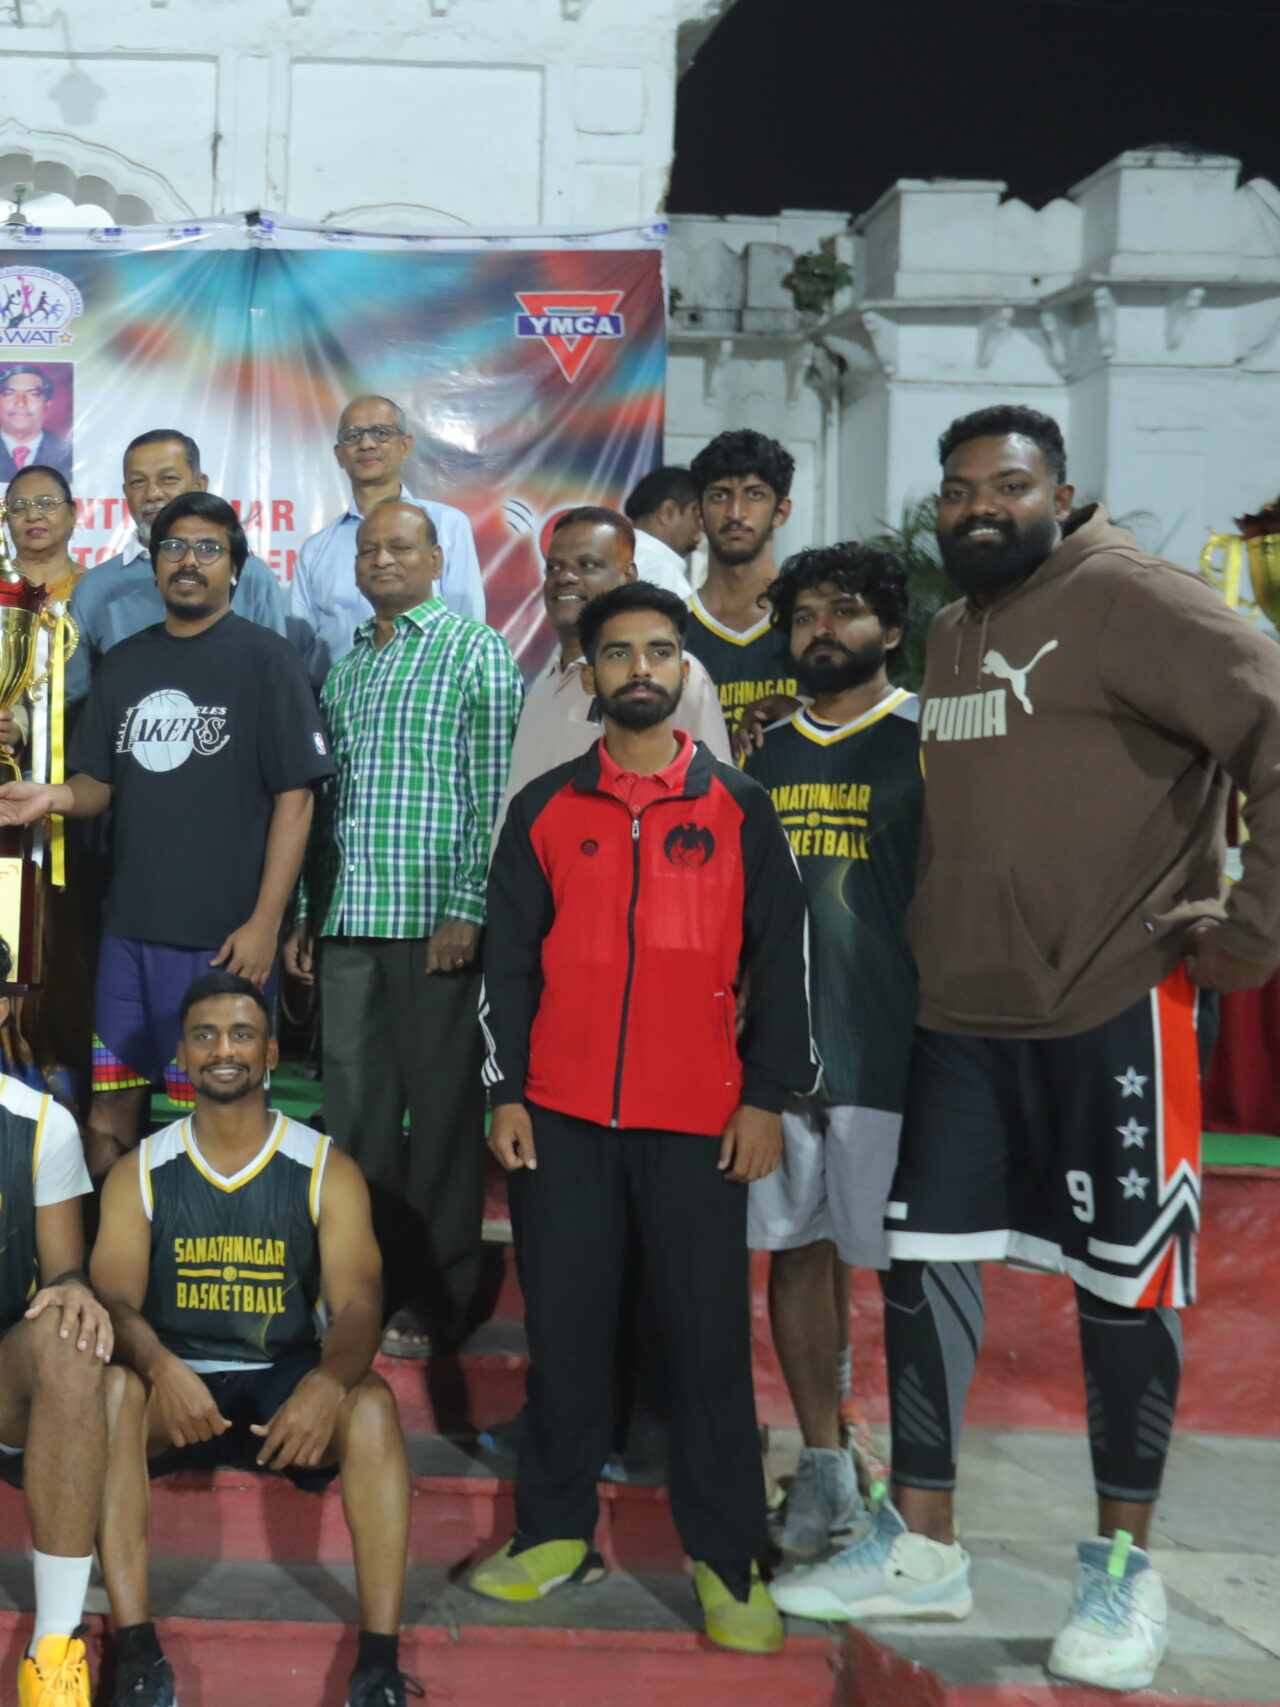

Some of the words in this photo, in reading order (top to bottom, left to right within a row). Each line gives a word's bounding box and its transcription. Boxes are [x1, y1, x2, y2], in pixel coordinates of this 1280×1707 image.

[528, 316, 615, 334] YMCA
[920, 688, 1007, 741] PUMA
[116, 707, 230, 755] LAKERS
[770, 783, 871, 812] ANATHNAGAR
[788, 829, 869, 859] KETBALL
[1066, 1170, 1095, 1224] 9
[174, 1236, 285, 1266] SANATHNAGAR
[176, 1282, 286, 1314] BASKETBALL
